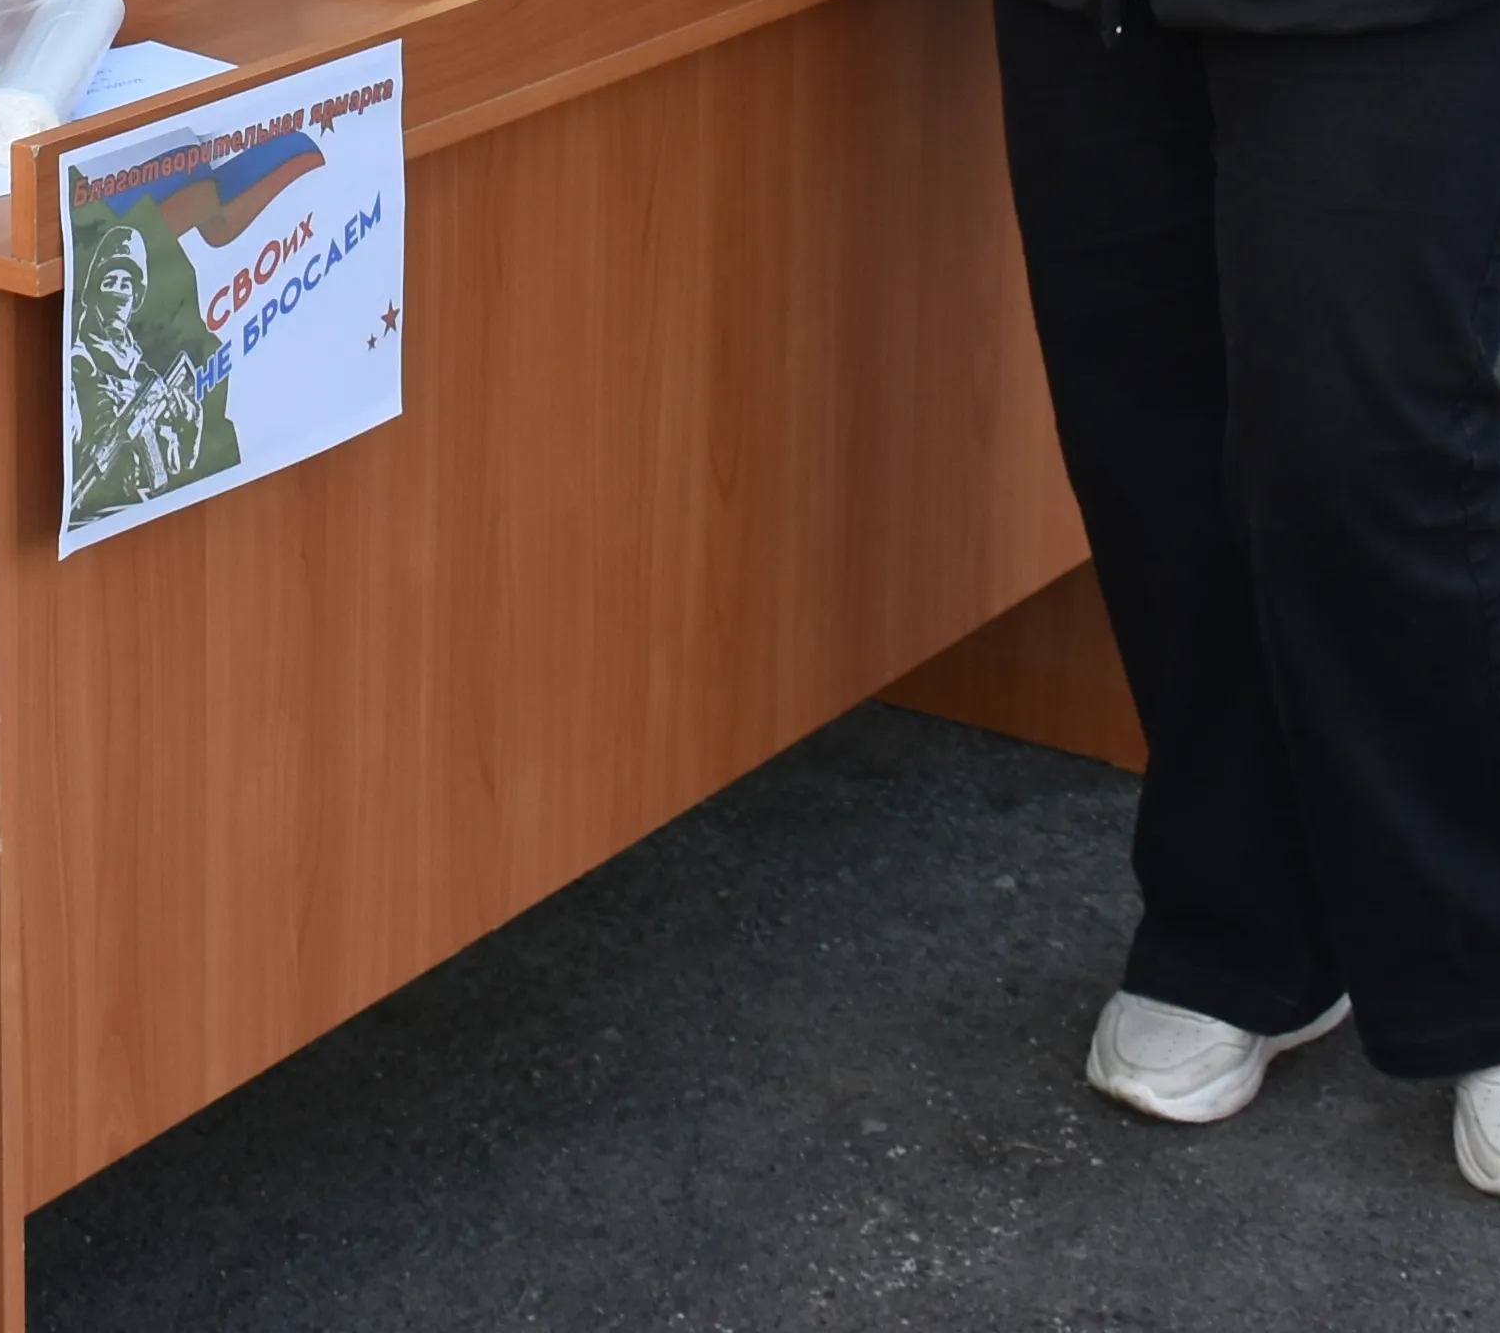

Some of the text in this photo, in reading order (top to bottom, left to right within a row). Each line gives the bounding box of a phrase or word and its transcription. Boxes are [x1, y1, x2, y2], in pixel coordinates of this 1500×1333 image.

[73, 78, 394, 208] Благотворительная ярмарка
[196, 190, 381, 401] НЕ БРОСАЕМ
